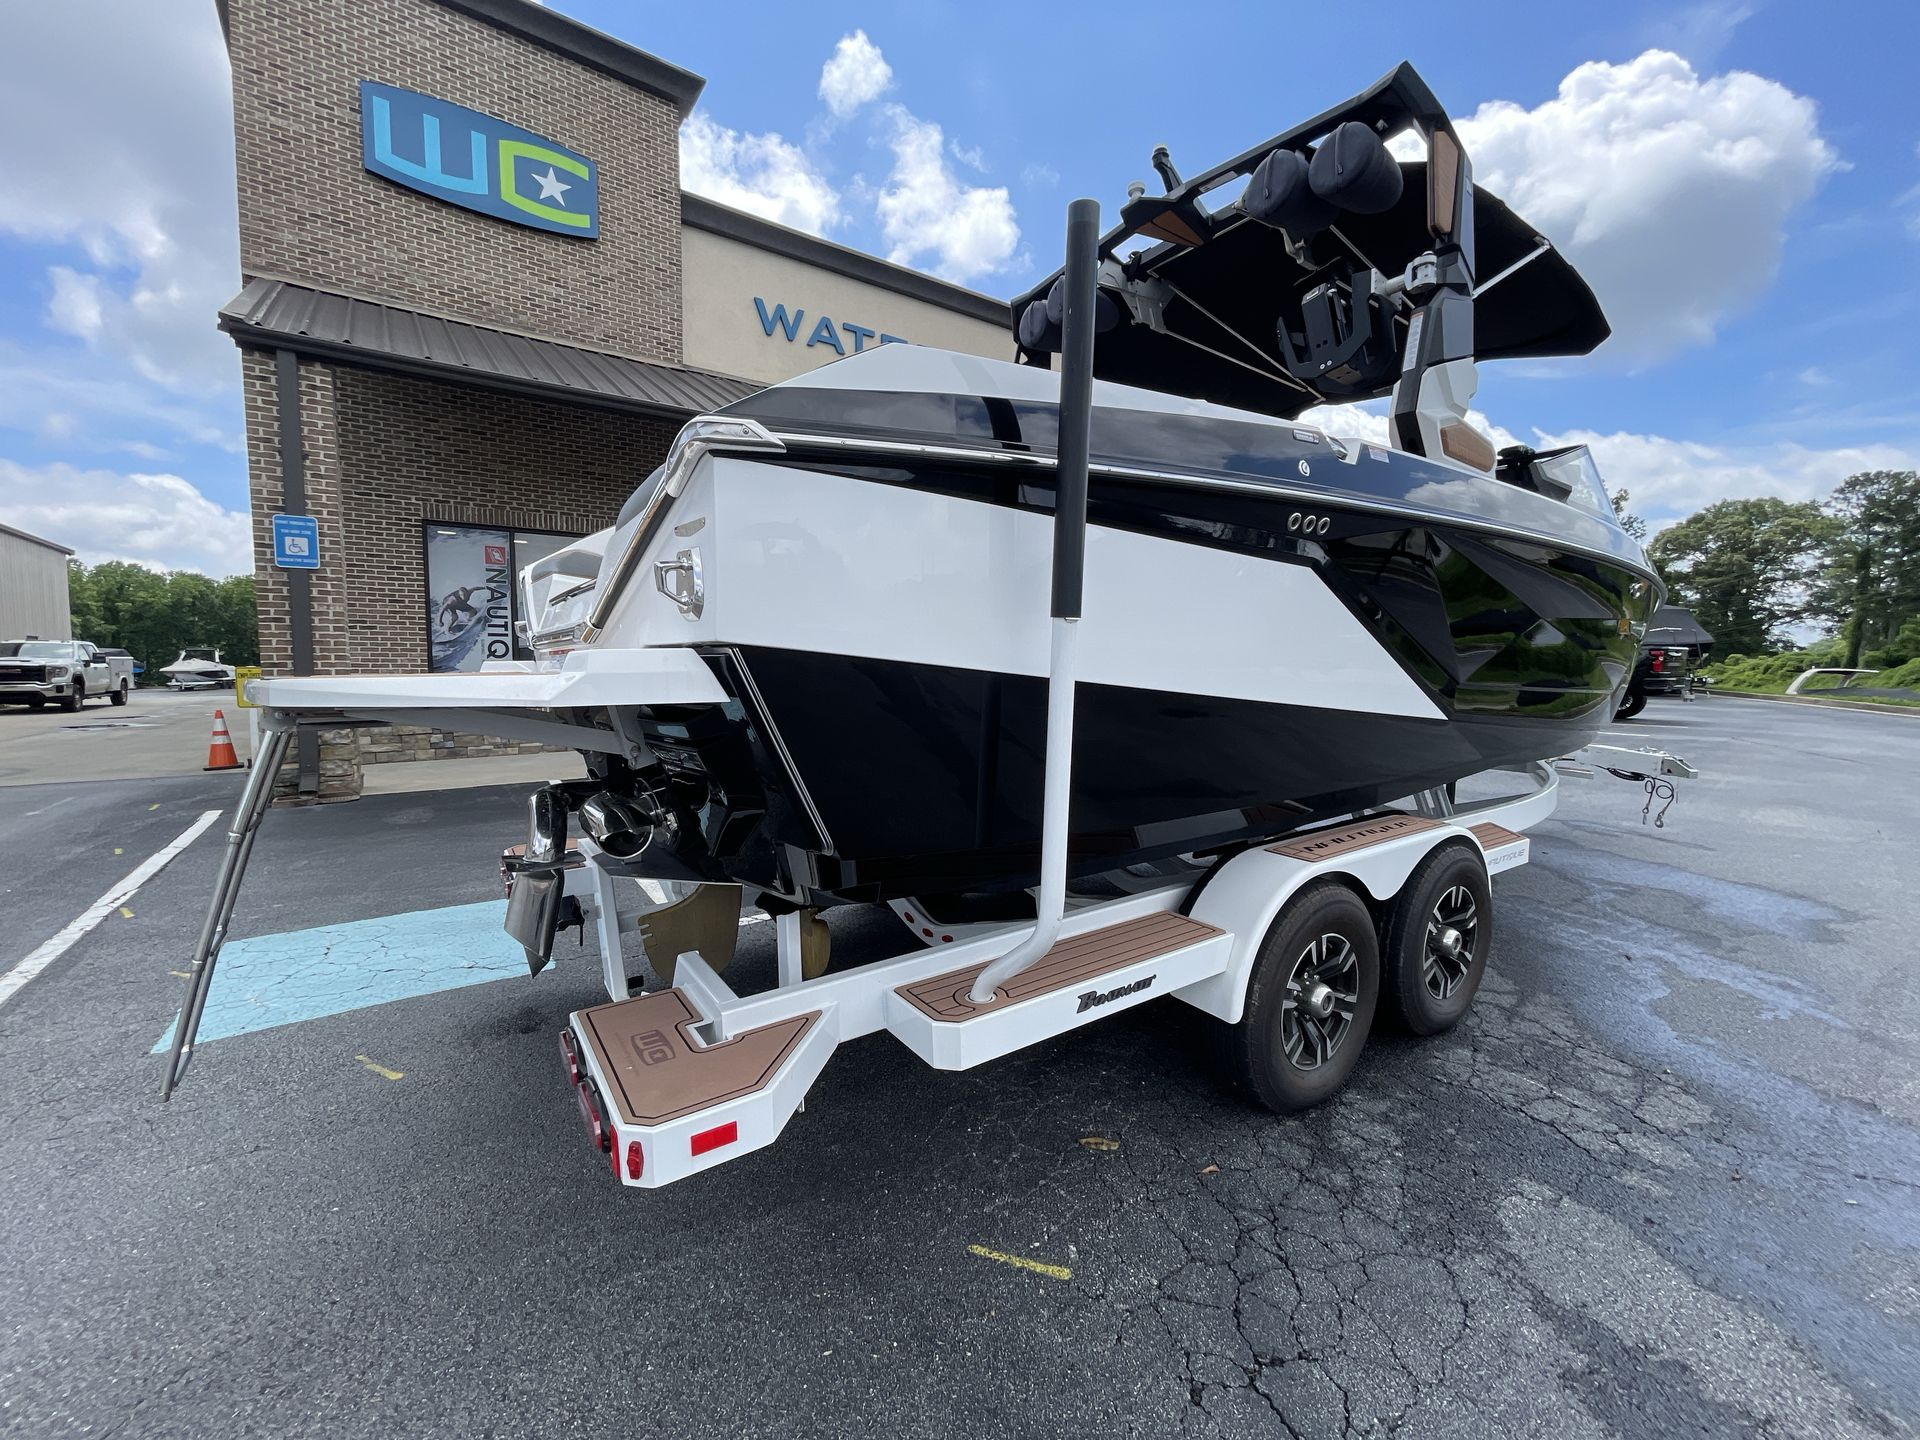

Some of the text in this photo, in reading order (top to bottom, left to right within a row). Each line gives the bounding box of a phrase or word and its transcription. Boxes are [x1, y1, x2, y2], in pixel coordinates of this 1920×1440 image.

[373, 95, 591, 228] WC
[753, 296, 909, 356] WAT
[485, 567, 510, 659] NAUTIQ
